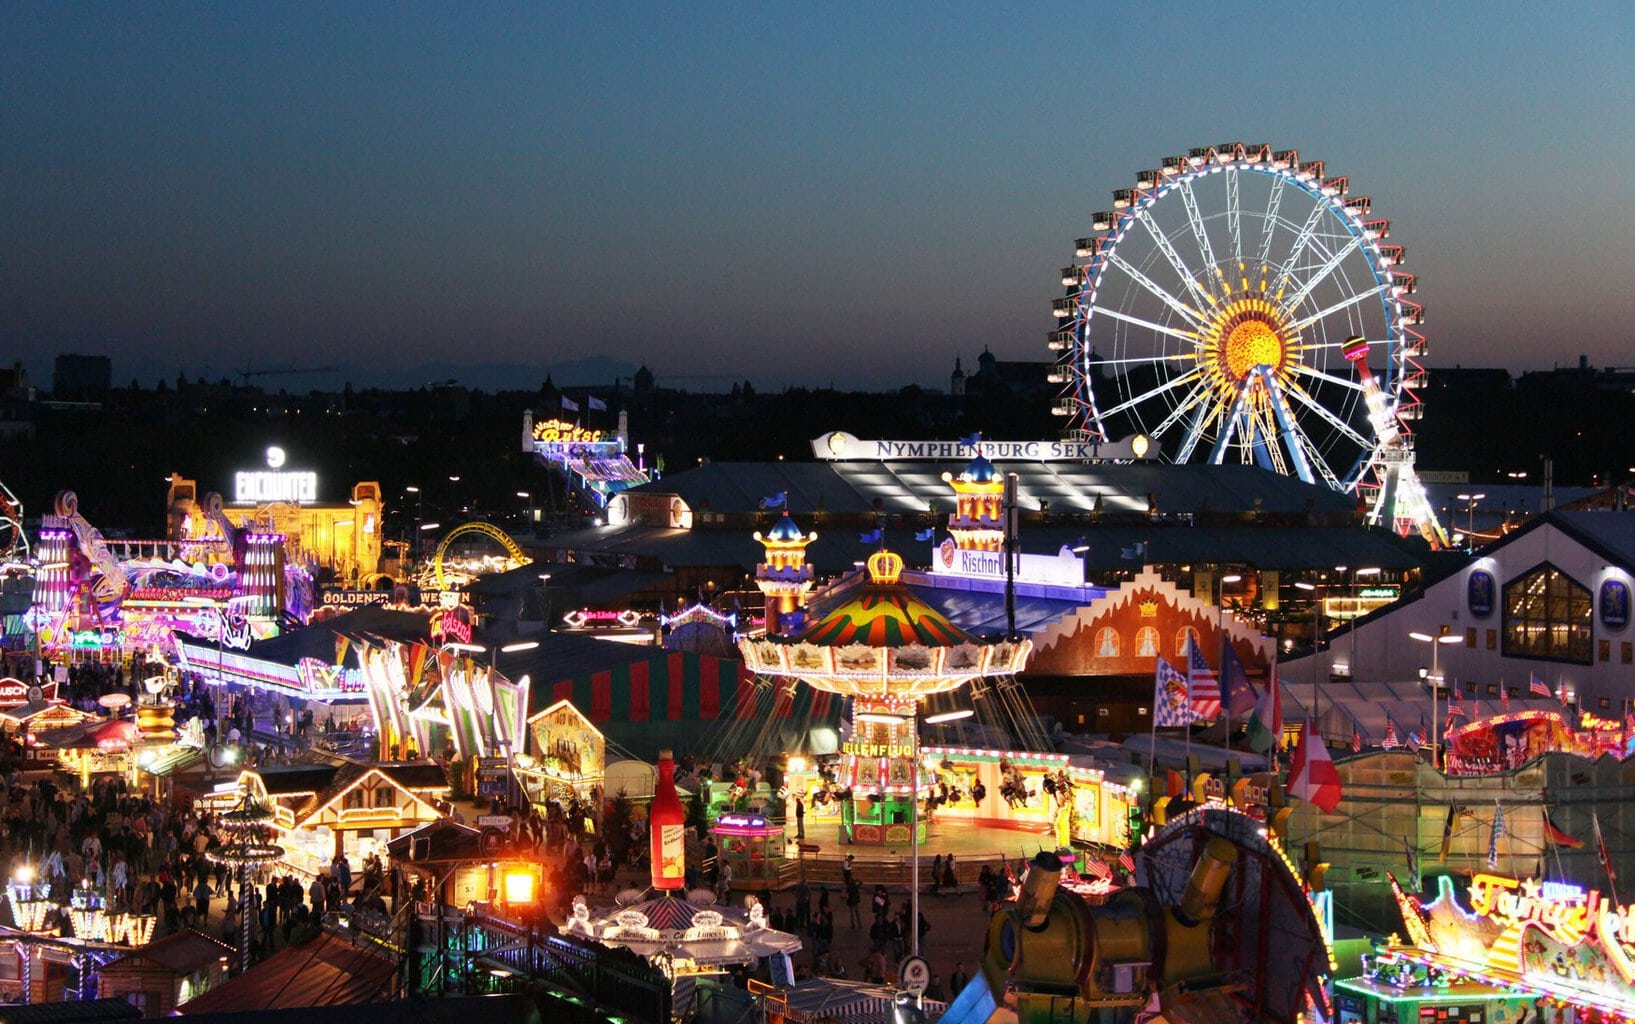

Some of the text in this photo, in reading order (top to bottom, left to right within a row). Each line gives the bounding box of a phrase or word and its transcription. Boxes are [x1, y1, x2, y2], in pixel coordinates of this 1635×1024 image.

[877, 441, 1101, 457] NYMPHENBURG SEKT
[235, 471, 317, 501] ENCOUNTER
[962, 551, 1004, 575] Rischar
[323, 593, 389, 604] GOLDENER
